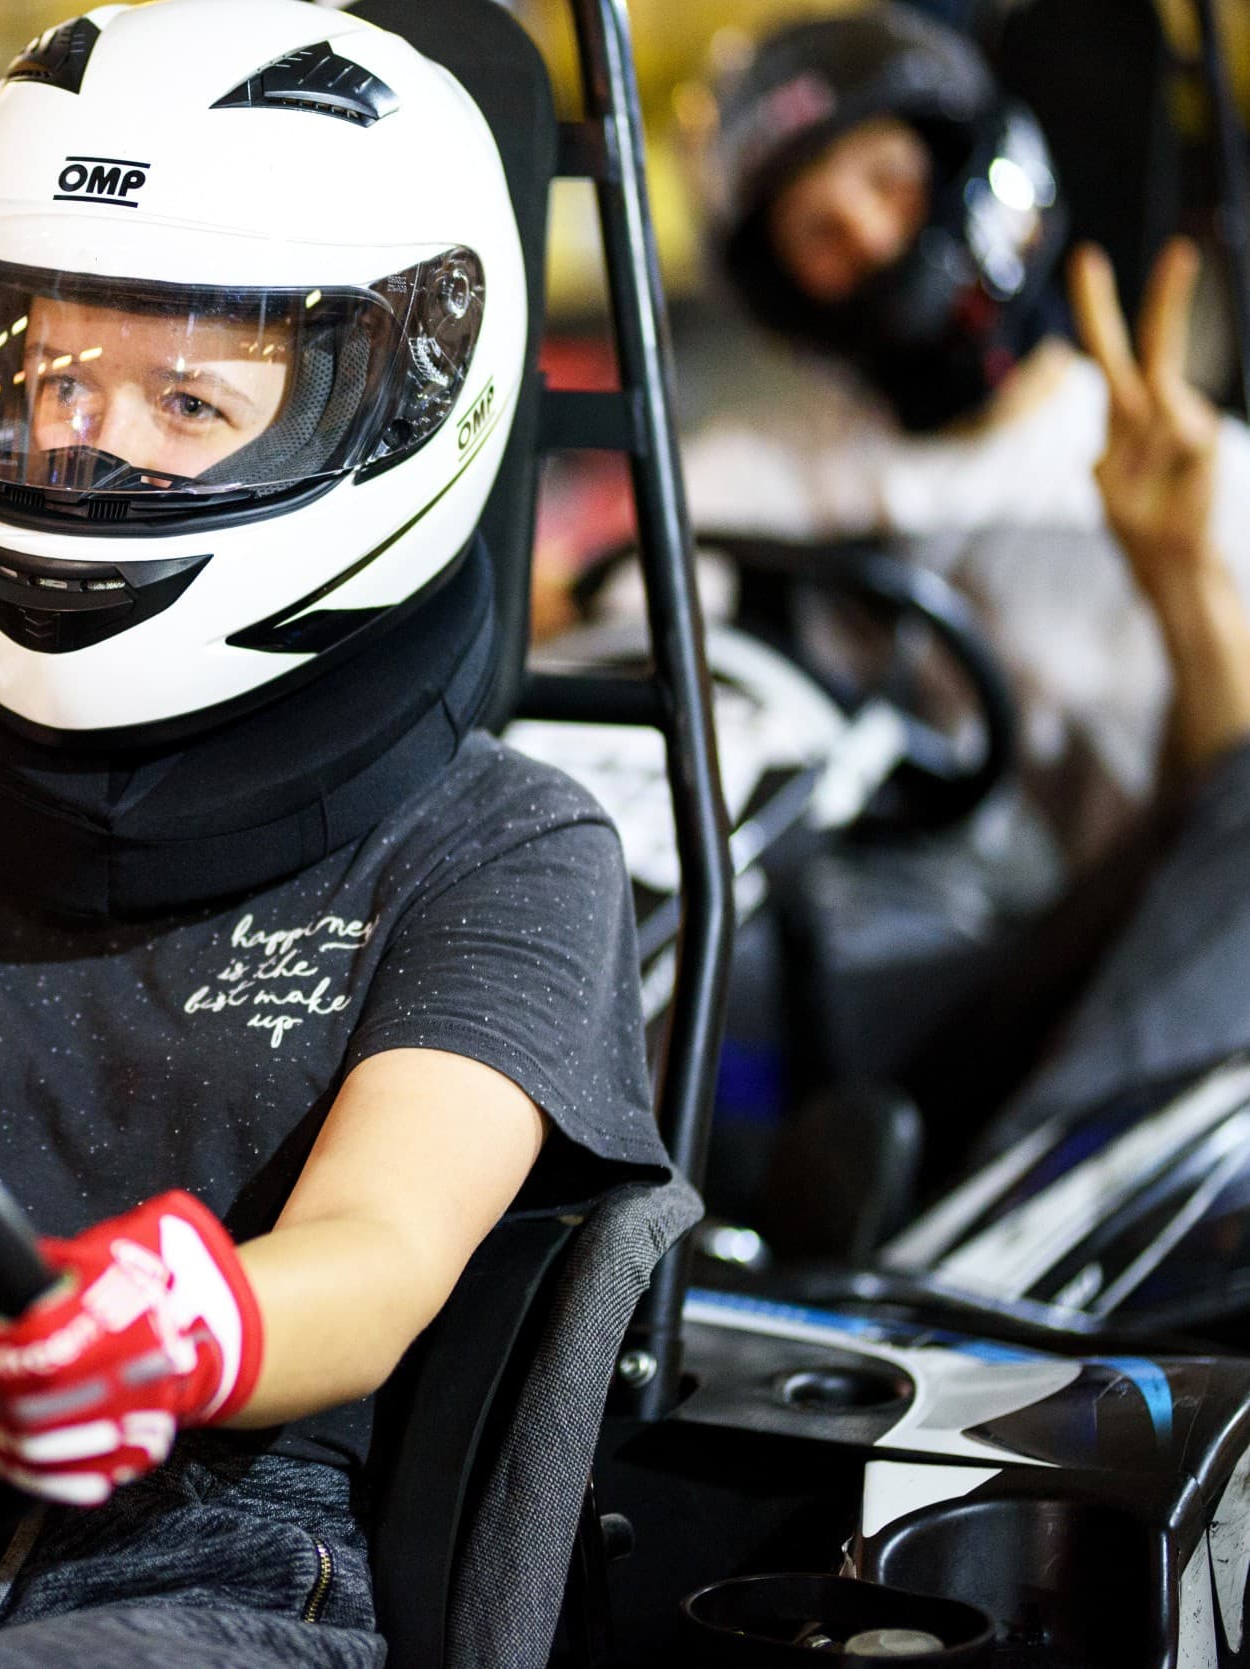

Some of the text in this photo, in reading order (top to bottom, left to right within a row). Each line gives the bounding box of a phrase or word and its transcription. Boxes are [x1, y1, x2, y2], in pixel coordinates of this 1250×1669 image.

[58, 163, 146, 197] OMP
[458, 385, 494, 450] OMP
[217, 949, 318, 981] is the
[184, 977, 352, 1014] best make
[247, 1013, 304, 1048] up
